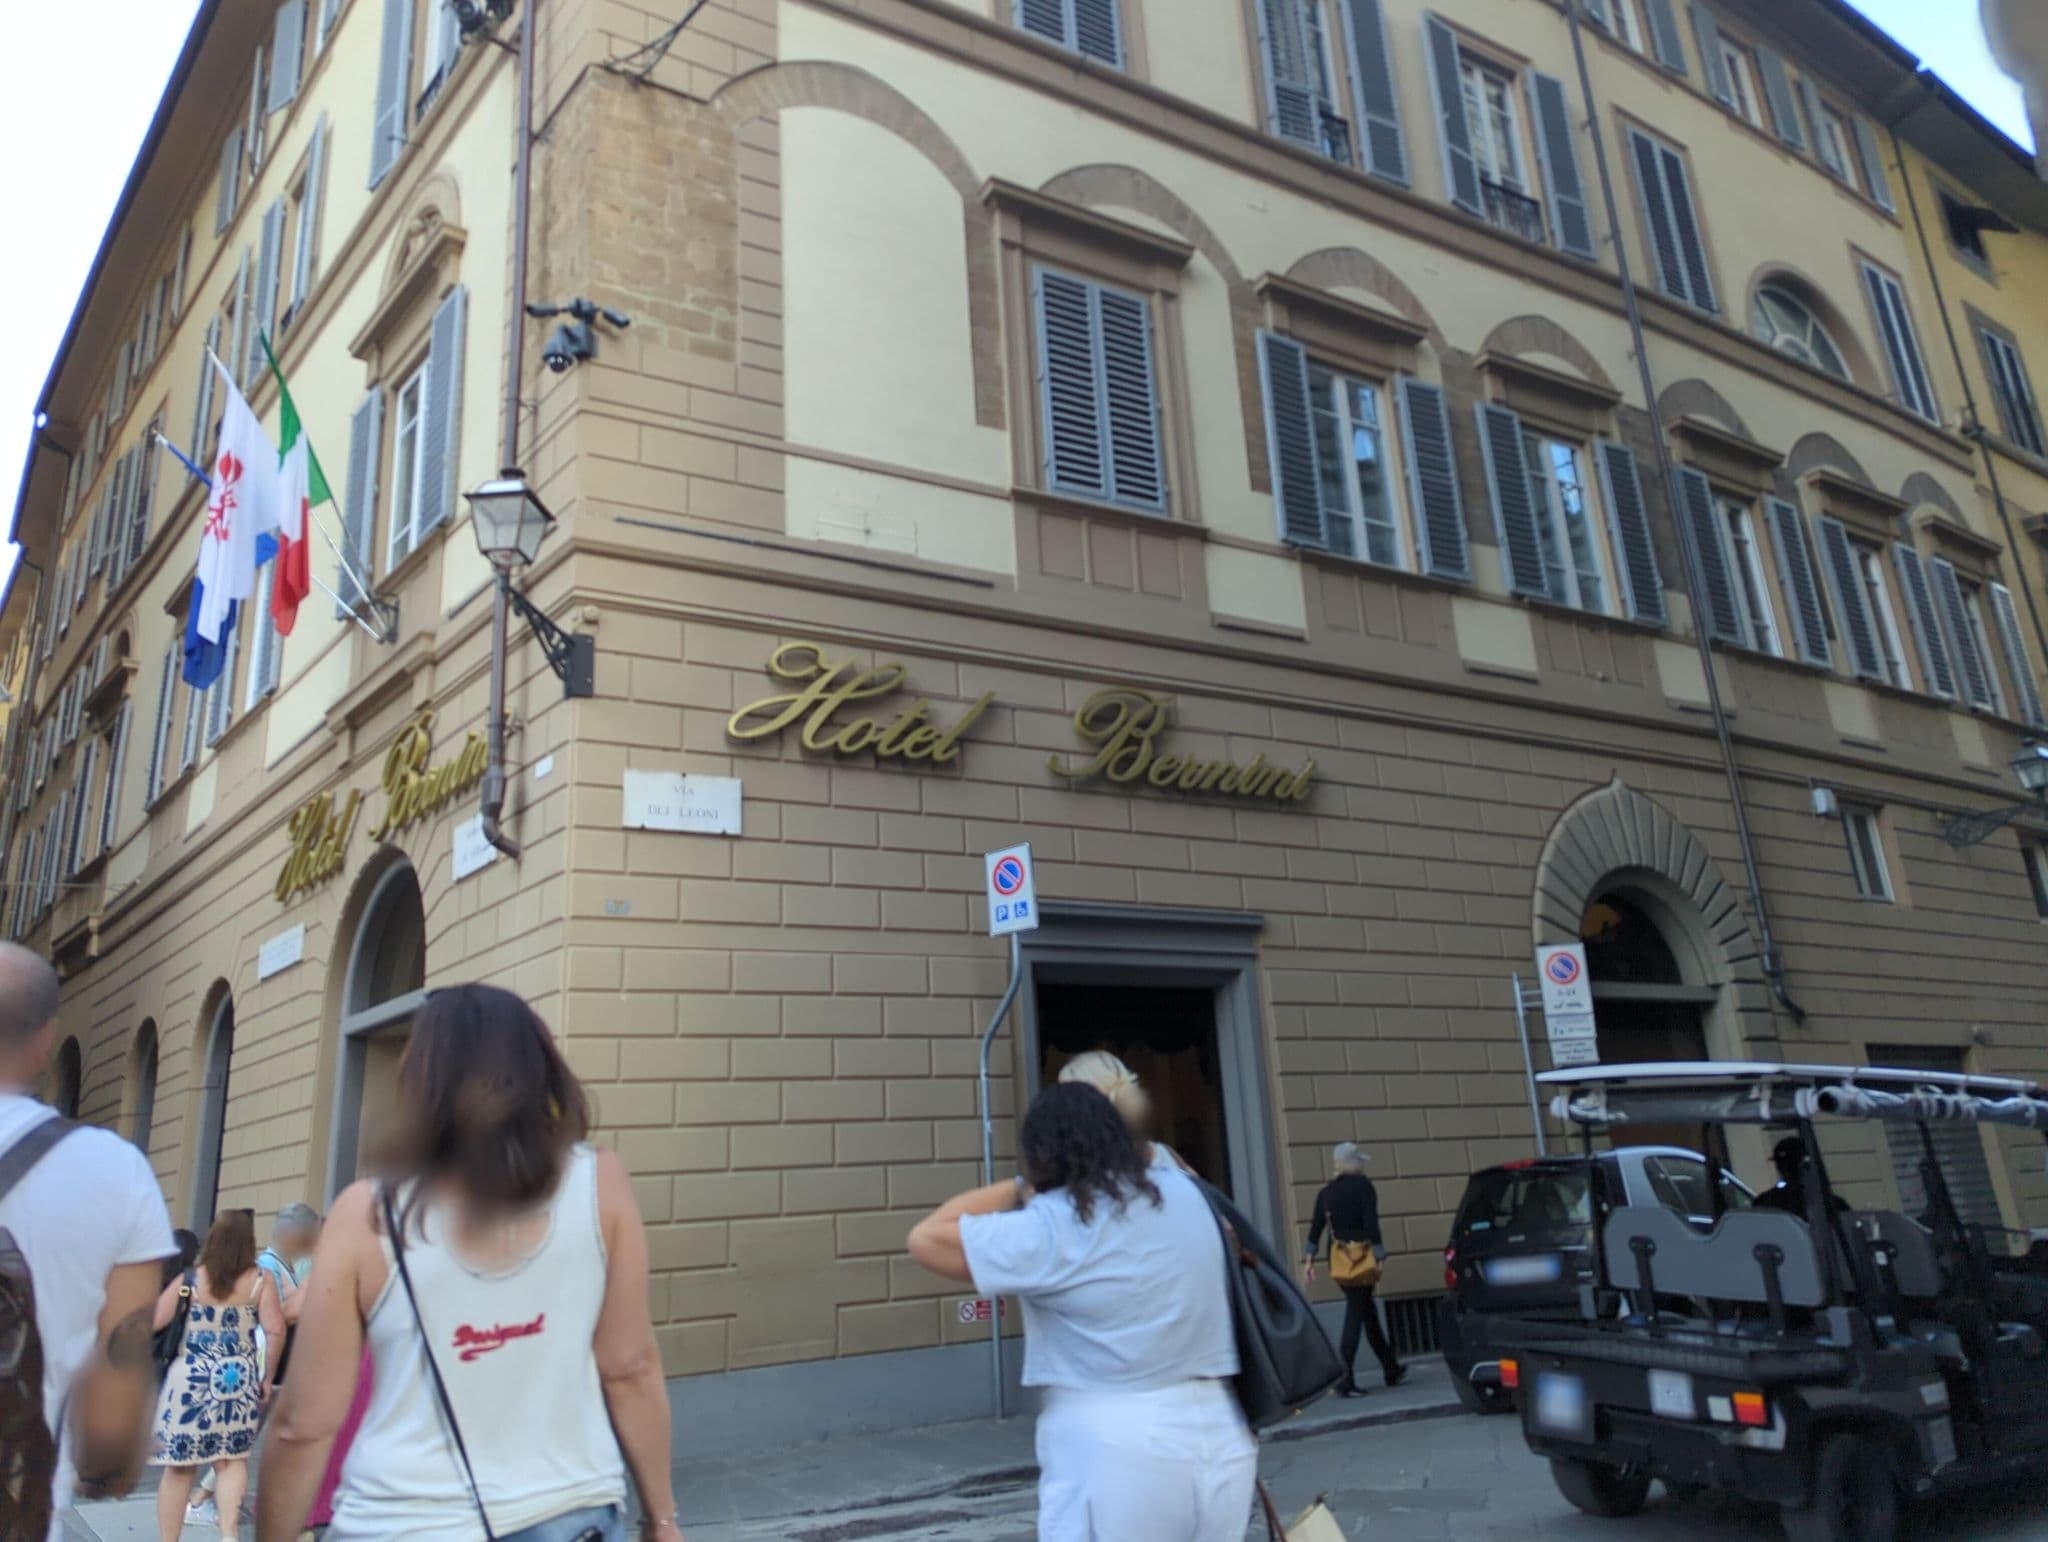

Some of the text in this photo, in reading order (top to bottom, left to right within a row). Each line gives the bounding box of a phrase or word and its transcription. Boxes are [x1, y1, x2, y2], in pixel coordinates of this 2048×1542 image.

[726, 641, 1321, 800] Hotel Bernini
[368, 709, 490, 842] Bernin
[648, 803, 719, 820] DEI LEONI
[673, 784, 695, 796] VIA
